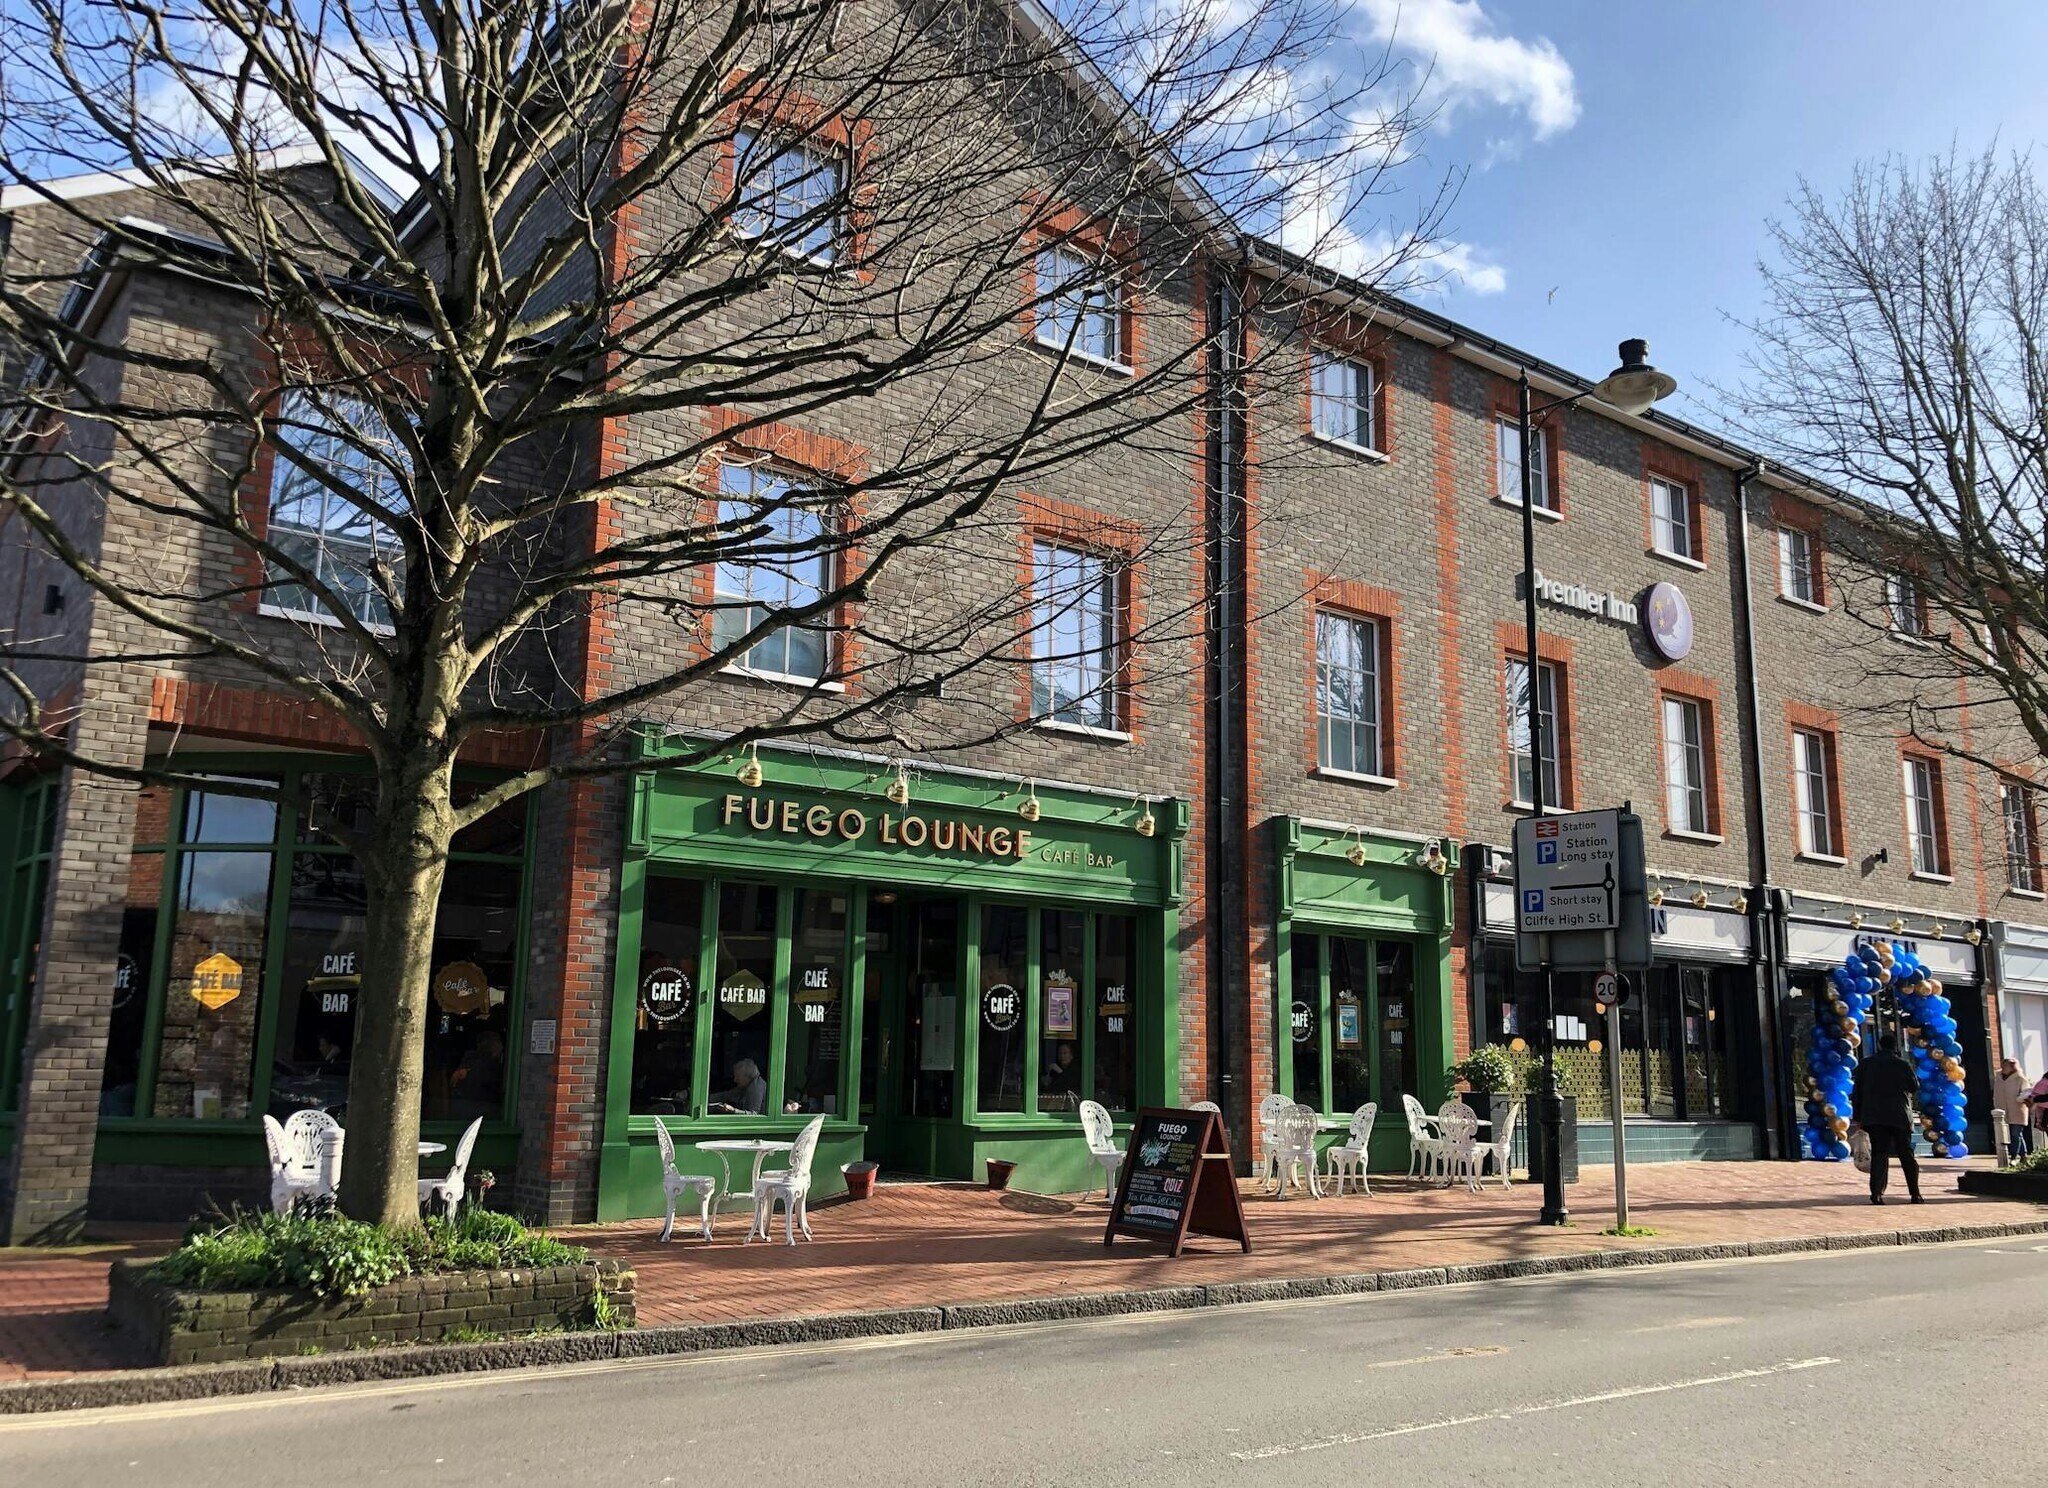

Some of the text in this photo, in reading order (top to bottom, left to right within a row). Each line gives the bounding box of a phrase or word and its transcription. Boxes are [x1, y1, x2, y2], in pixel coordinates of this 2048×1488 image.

[1533, 568, 1638, 625] Premier Inn
[724, 794, 1032, 858] FUEGO LOUNGE
[1562, 821, 1597, 832] Station
[1566, 836, 1608, 849] Station
[1041, 847, 1114, 869] CAFÉ BAR
[1561, 850, 1614, 863] Long stay
[1550, 894, 1602, 906] Short stay
[1524, 913, 1605, 927] Cliffe High St.
[323, 952, 355, 974] CAFÉ
[443, 977, 469, 991] Café
[804, 967, 829, 988] CAFÉ
[651, 978, 683, 1002] CAFÉ
[720, 984, 766, 1004] CAFÉ BAR
[1106, 985, 1126, 1003] CAFÉ
[1597, 982, 1615, 996] 20
[322, 994, 349, 1013] BAR
[990, 994, 1014, 1014] CAFÉ
[1388, 1003, 1404, 1019] CAFÉ
[804, 1004, 825, 1022] BAR
[1291, 1009, 1309, 1028] CAFÉ
[1107, 1017, 1124, 1033] BAR
[1390, 1031, 1403, 1045] BAR
[1158, 1123, 1188, 1135] FUEGO
[1159, 1133, 1183, 1142] LOUNGE
[1163, 1177, 1184, 1193] QUIZ
